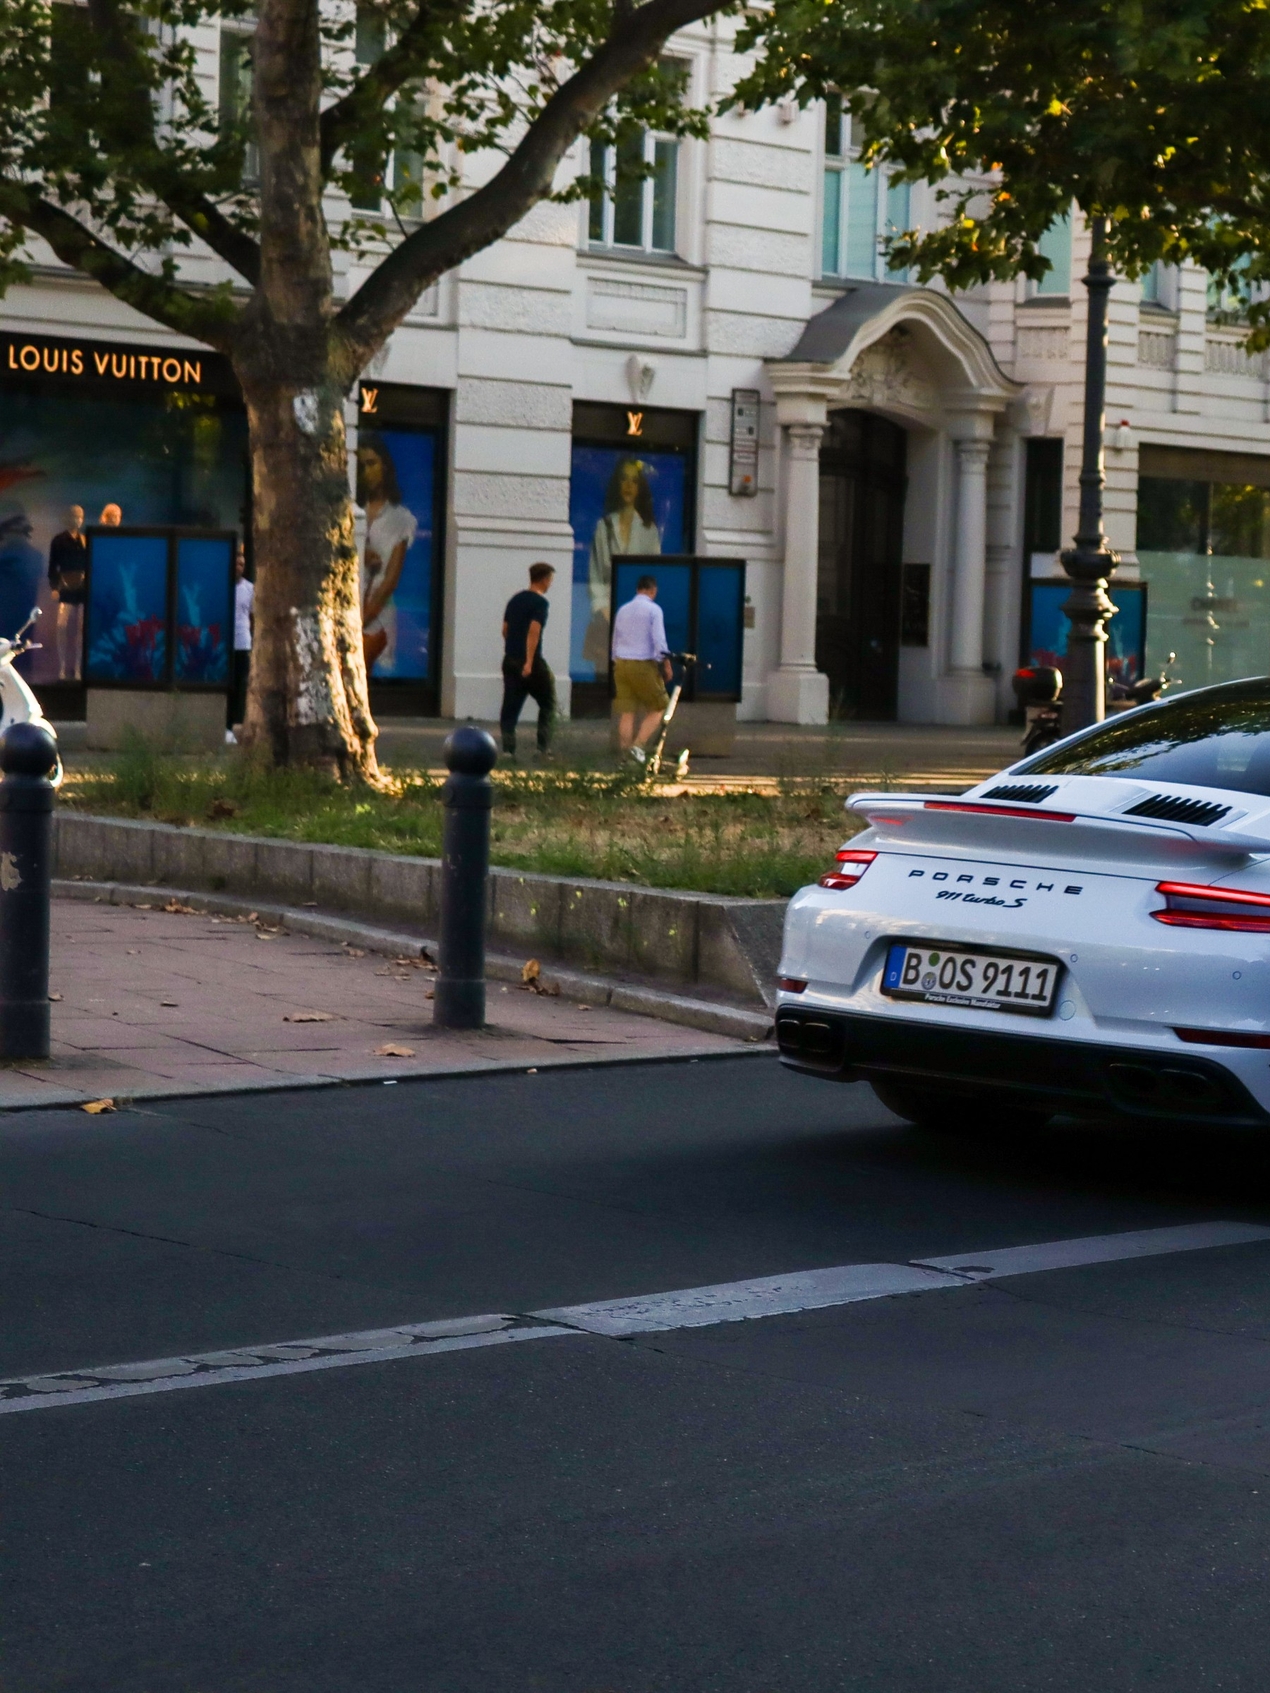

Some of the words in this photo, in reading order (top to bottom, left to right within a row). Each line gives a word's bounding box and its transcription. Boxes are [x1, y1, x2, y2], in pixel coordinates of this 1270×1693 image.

[9, 344, 84, 375] LOUIS
[94, 351, 201, 384] VUITTON
[908, 869, 1083, 895] PORSCHE
[935, 890, 962, 901] 911
[961, 893, 1005, 906] turbo
[1002, 898, 1028, 908] S
[902, 952, 922, 985] B
[938, 956, 976, 992] OS
[981, 961, 1049, 1002] 9111
